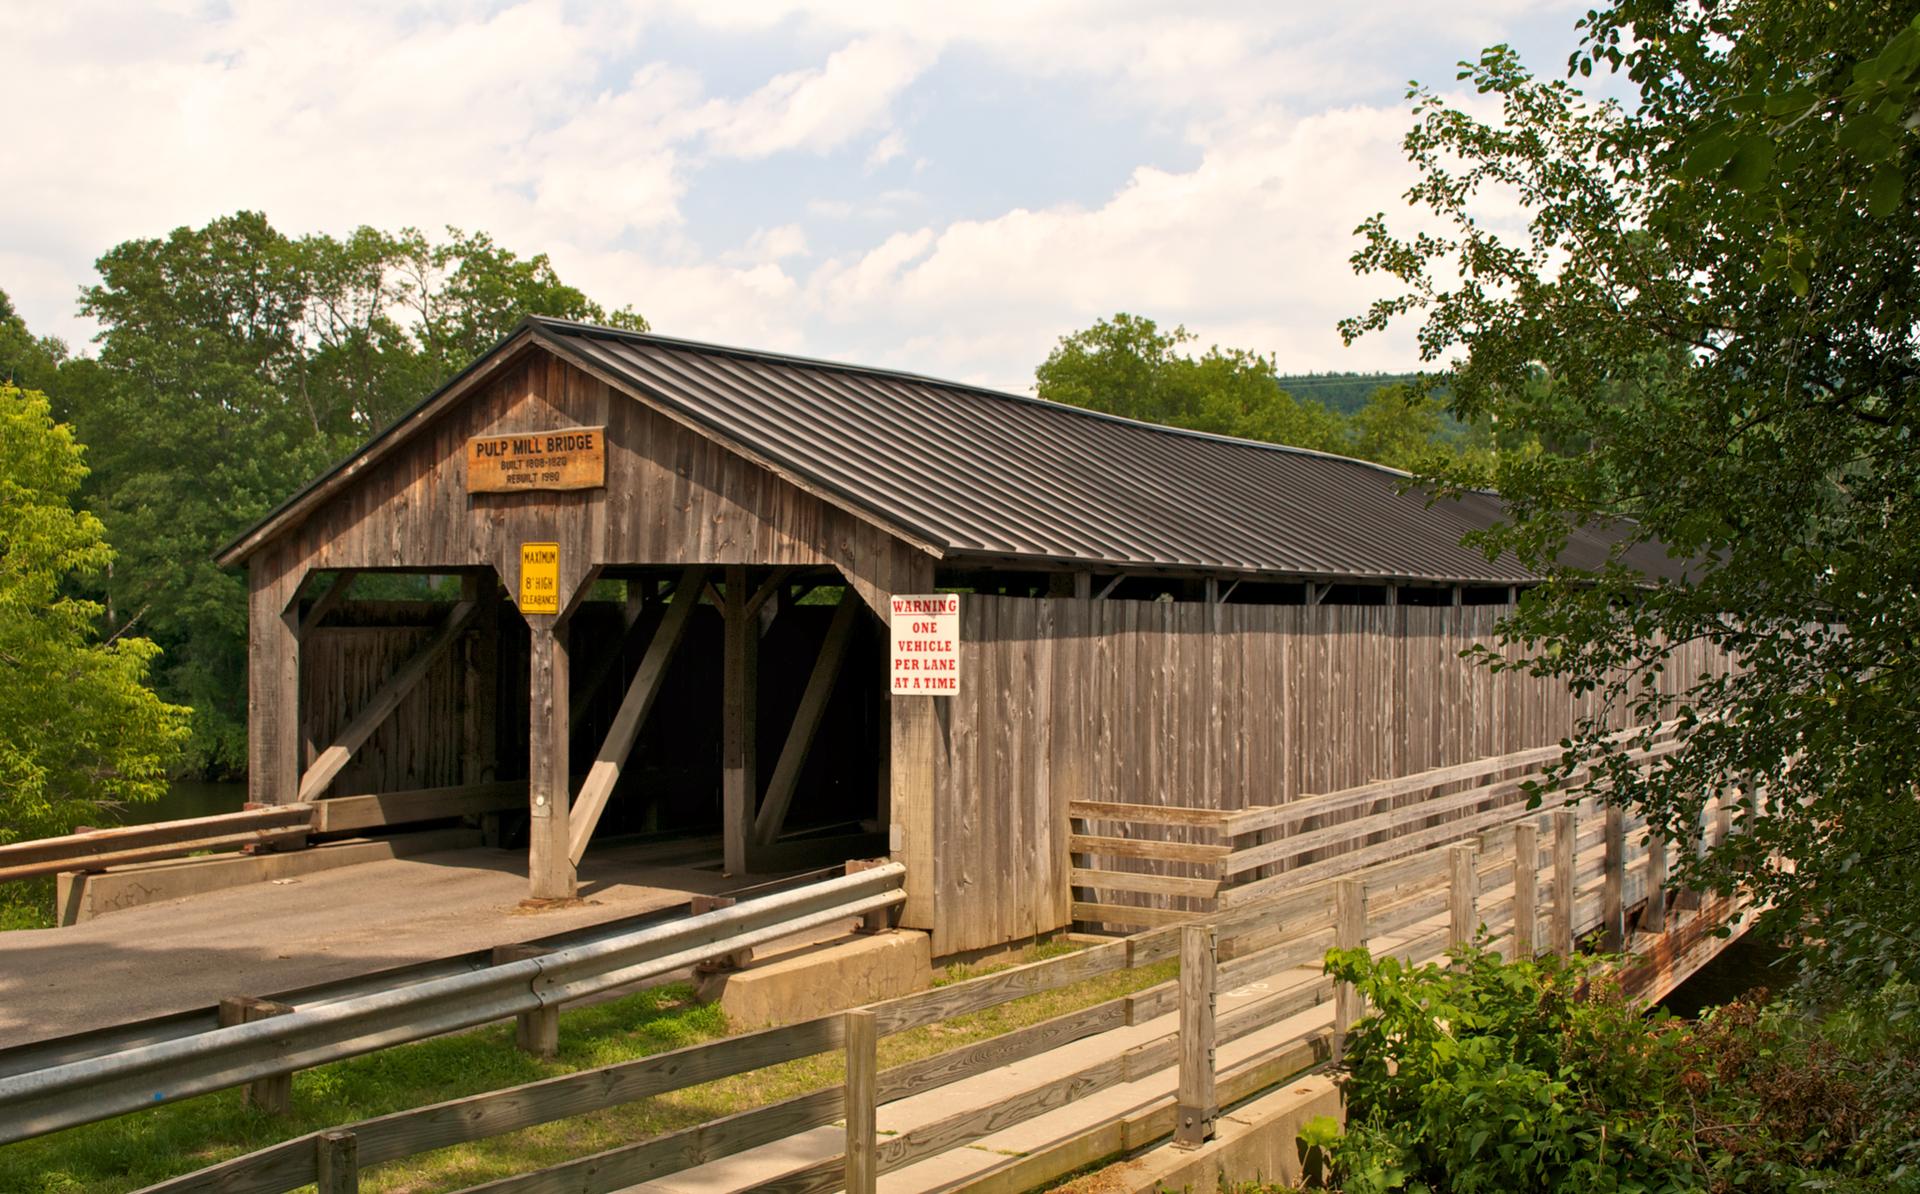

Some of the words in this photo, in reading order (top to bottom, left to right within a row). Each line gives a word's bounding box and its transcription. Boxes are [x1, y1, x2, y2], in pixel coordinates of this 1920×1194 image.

[476, 441, 508, 457] PULP
[513, 437, 542, 455] MILL
[547, 434, 593, 452] BRIDGE
[501, 459, 523, 471] BUILT
[506, 472, 537, 484] REBUILT
[524, 551, 556, 564] MAXIMUM
[535, 576, 553, 590] HIGH
[521, 594, 557, 605] CLEARANCE
[893, 600, 956, 613] WARNING
[912, 622, 937, 633] ONE
[898, 640, 952, 652] VEHICLE
[895, 659, 919, 671] PER
[923, 659, 956, 671] LANE
[894, 677, 909, 689] AT
[913, 677, 921, 689] A
[924, 677, 956, 689] TIME
